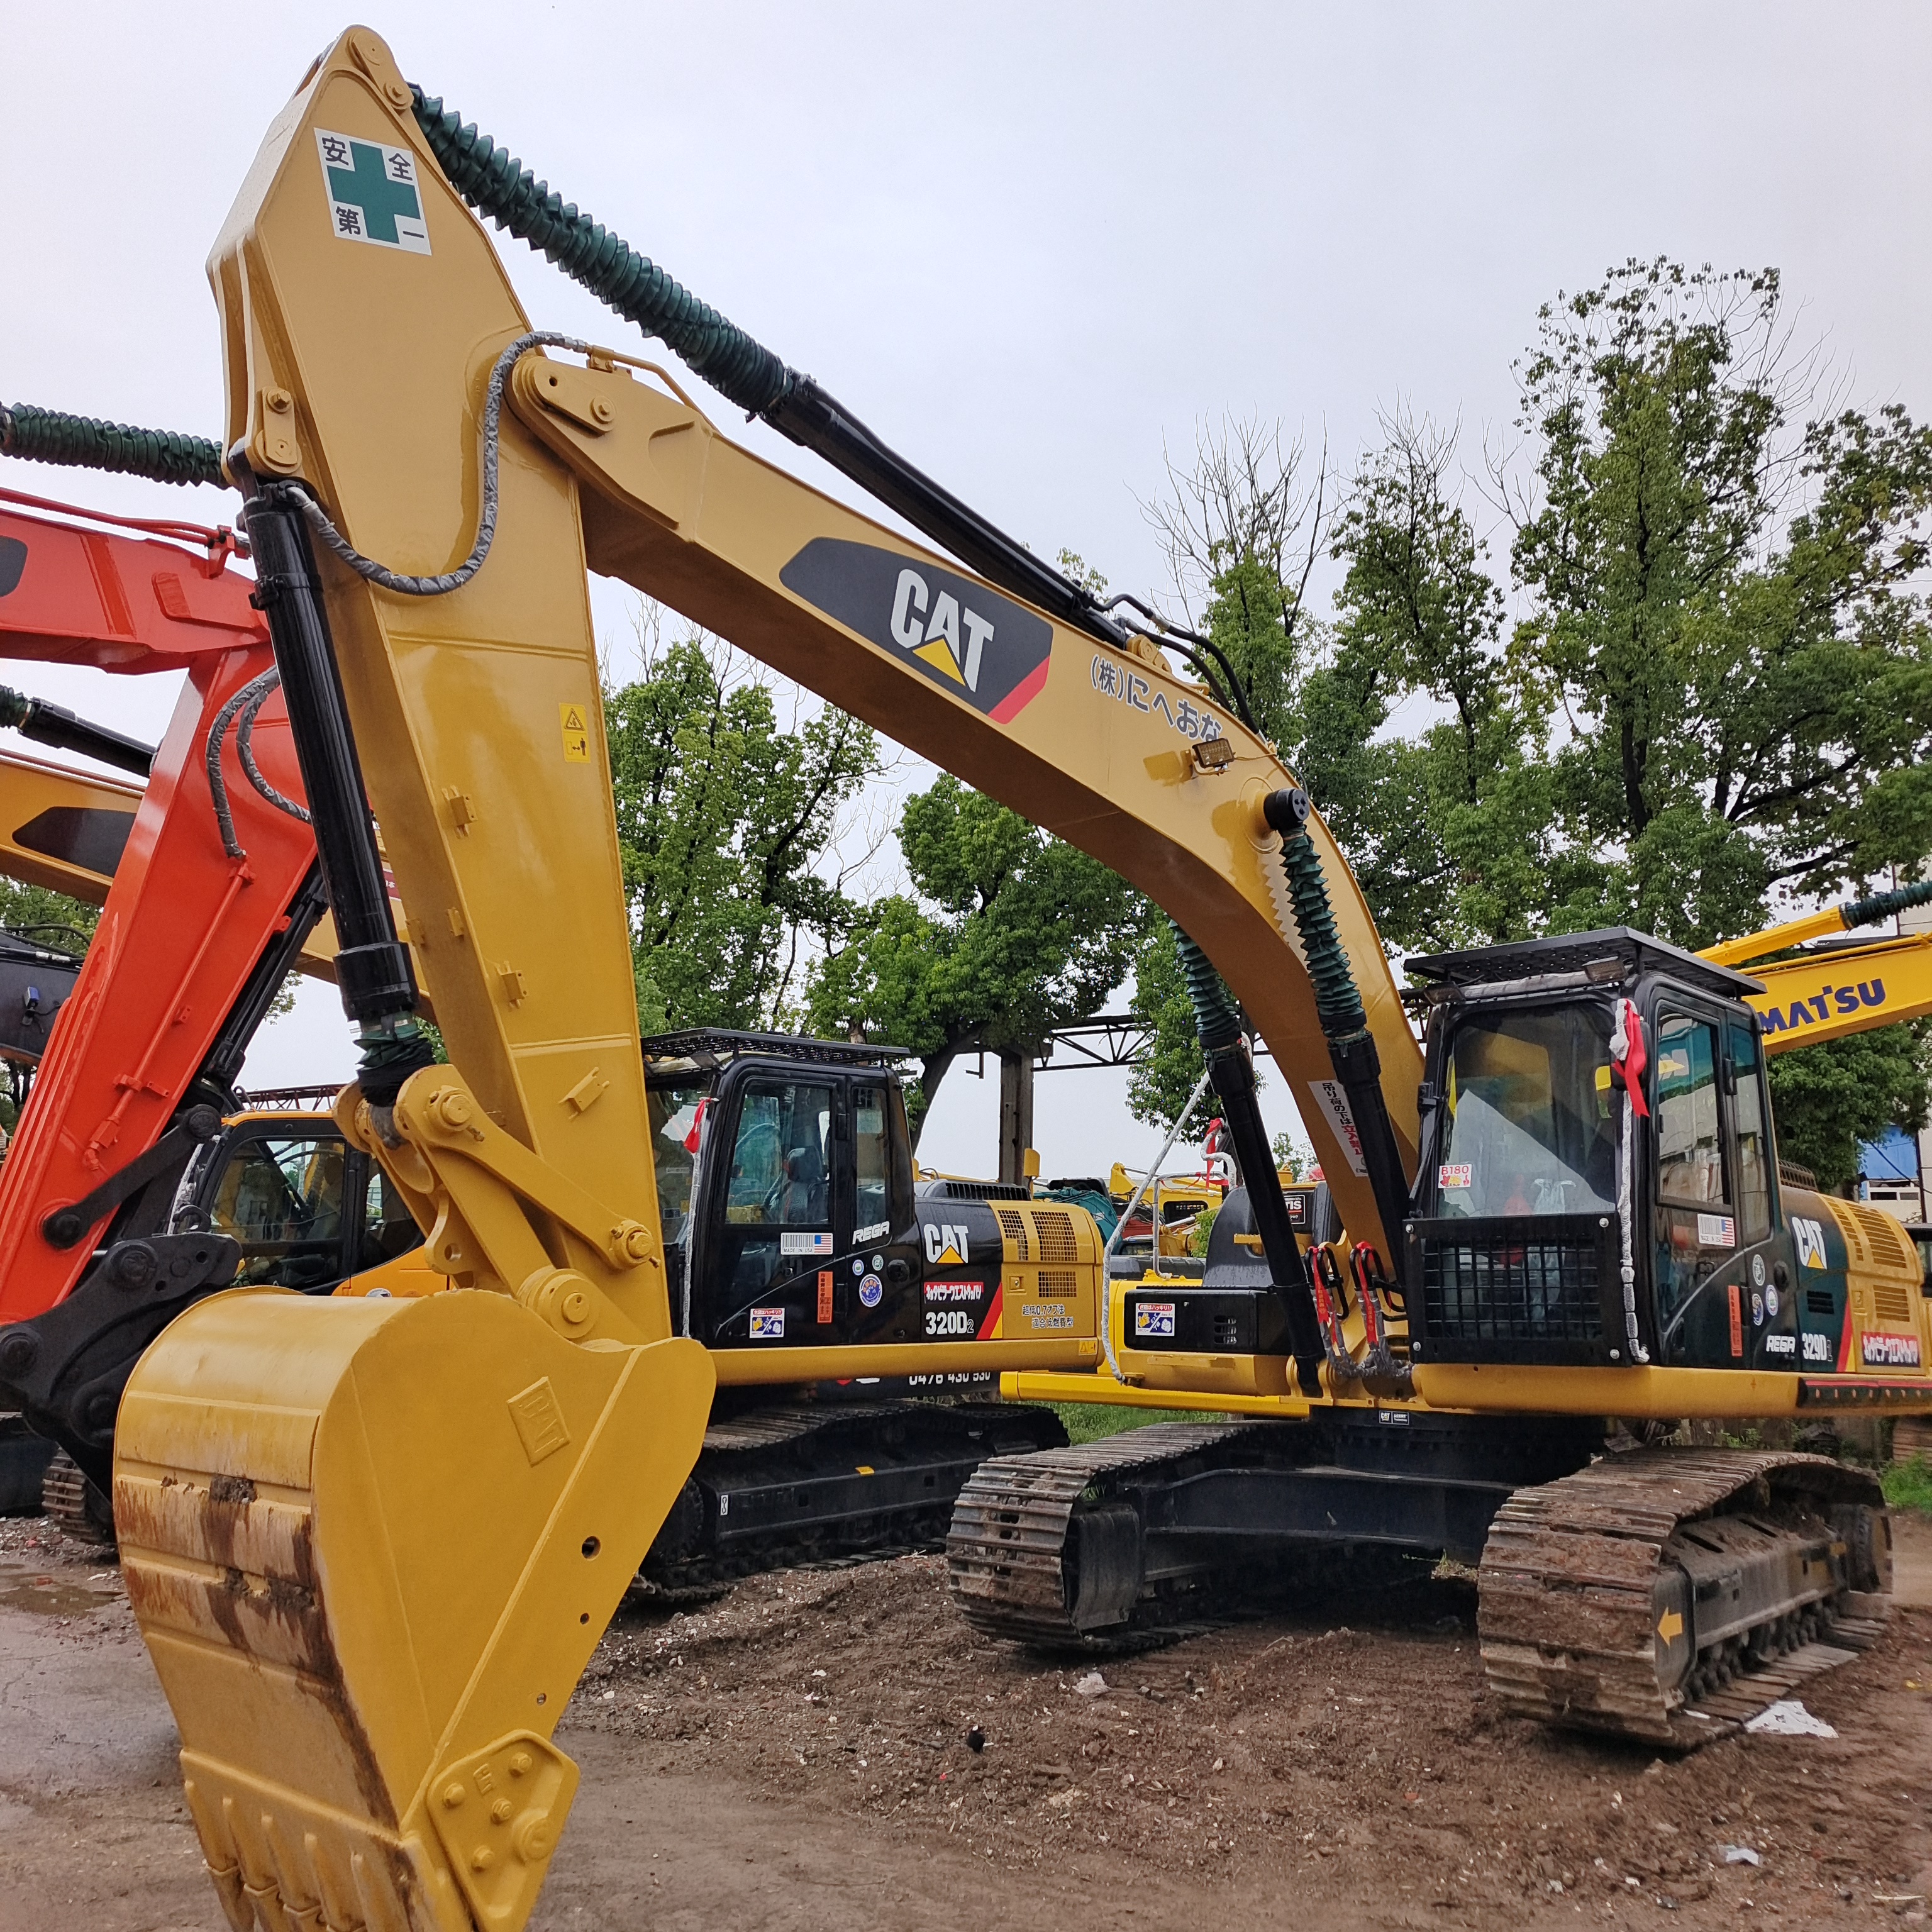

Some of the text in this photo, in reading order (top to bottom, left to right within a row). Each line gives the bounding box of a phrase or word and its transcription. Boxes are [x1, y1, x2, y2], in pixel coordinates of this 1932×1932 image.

[321, 136, 413, 181] 安 全
[335, 206, 361, 235] 第
[890, 569, 994, 692] CAT
[1441, 1165, 1470, 1175] B180
[852, 1221, 890, 1245] REGA
[923, 1224, 969, 1263] CAT
[1791, 1216, 1828, 1270] CAT
